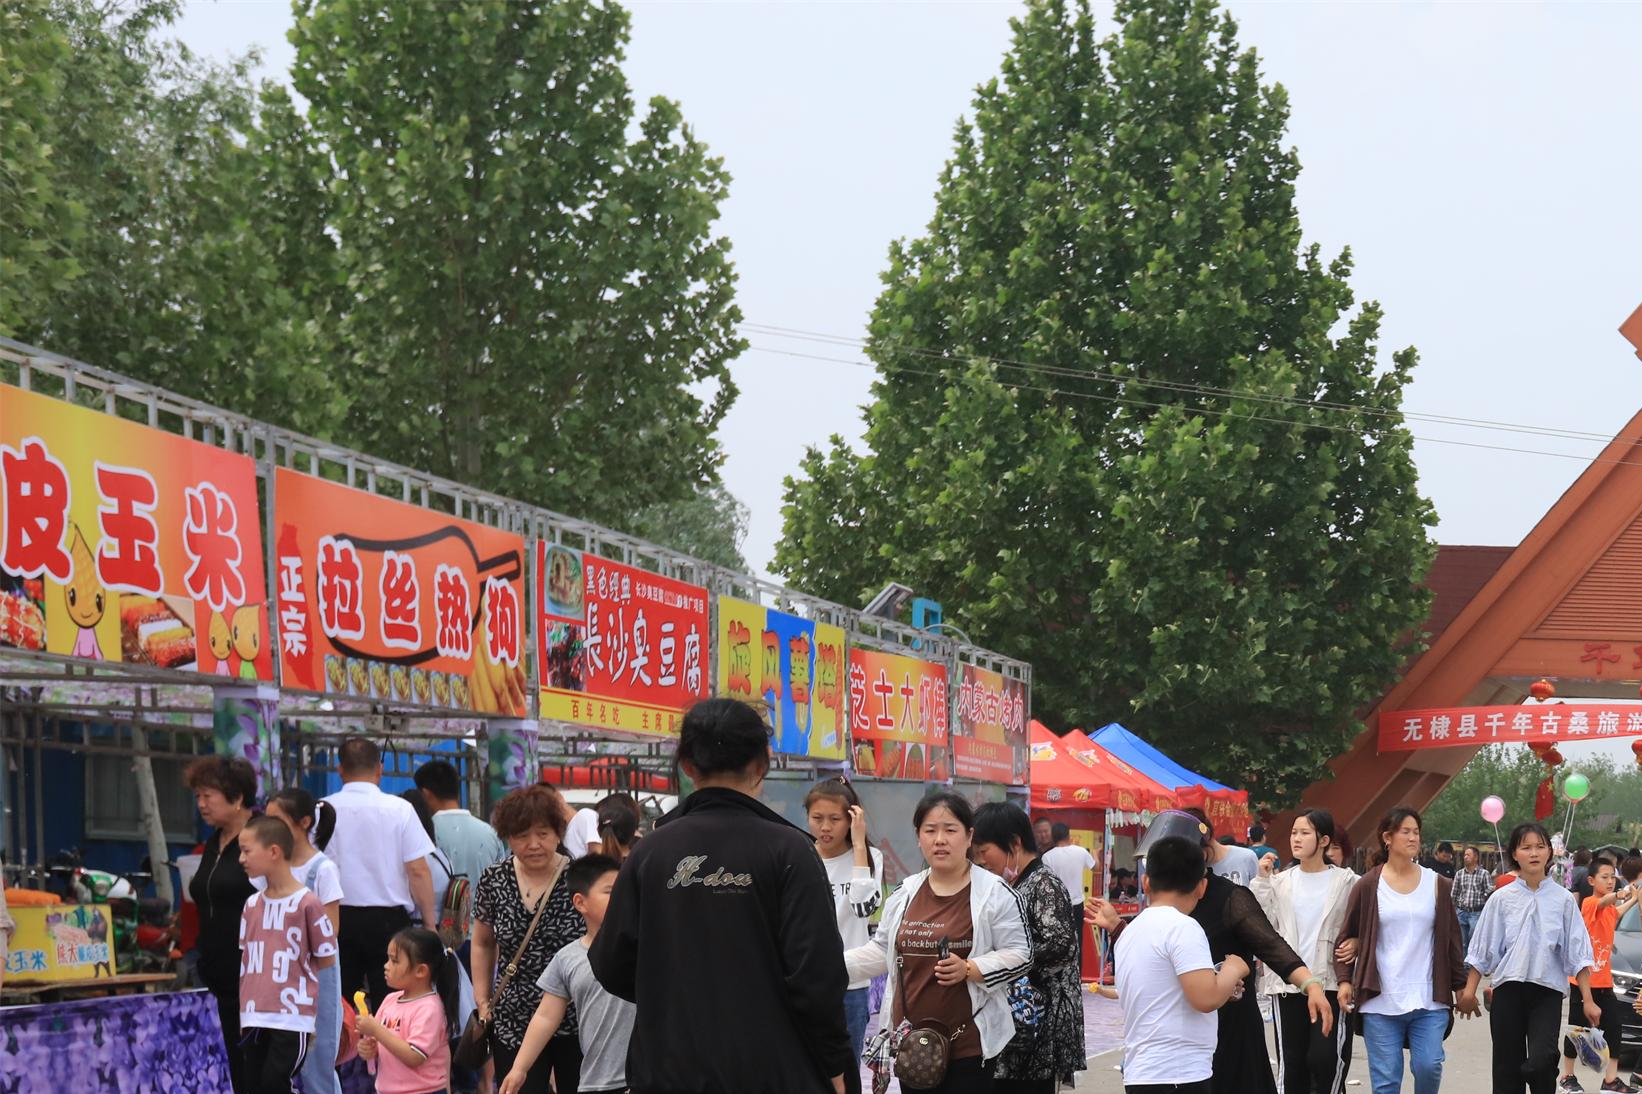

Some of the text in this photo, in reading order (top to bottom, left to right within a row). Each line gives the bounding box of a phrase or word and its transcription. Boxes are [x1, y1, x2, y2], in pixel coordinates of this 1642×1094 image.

[1, 437, 245, 612] 皮玉米
[278, 556, 308, 657] 正宗
[318, 535, 520, 668] 拉丝热狗
[850, 663, 947, 738] 芝士大虾棒
[907, 938, 924, 948] back
[925, 940, 938, 949] but
